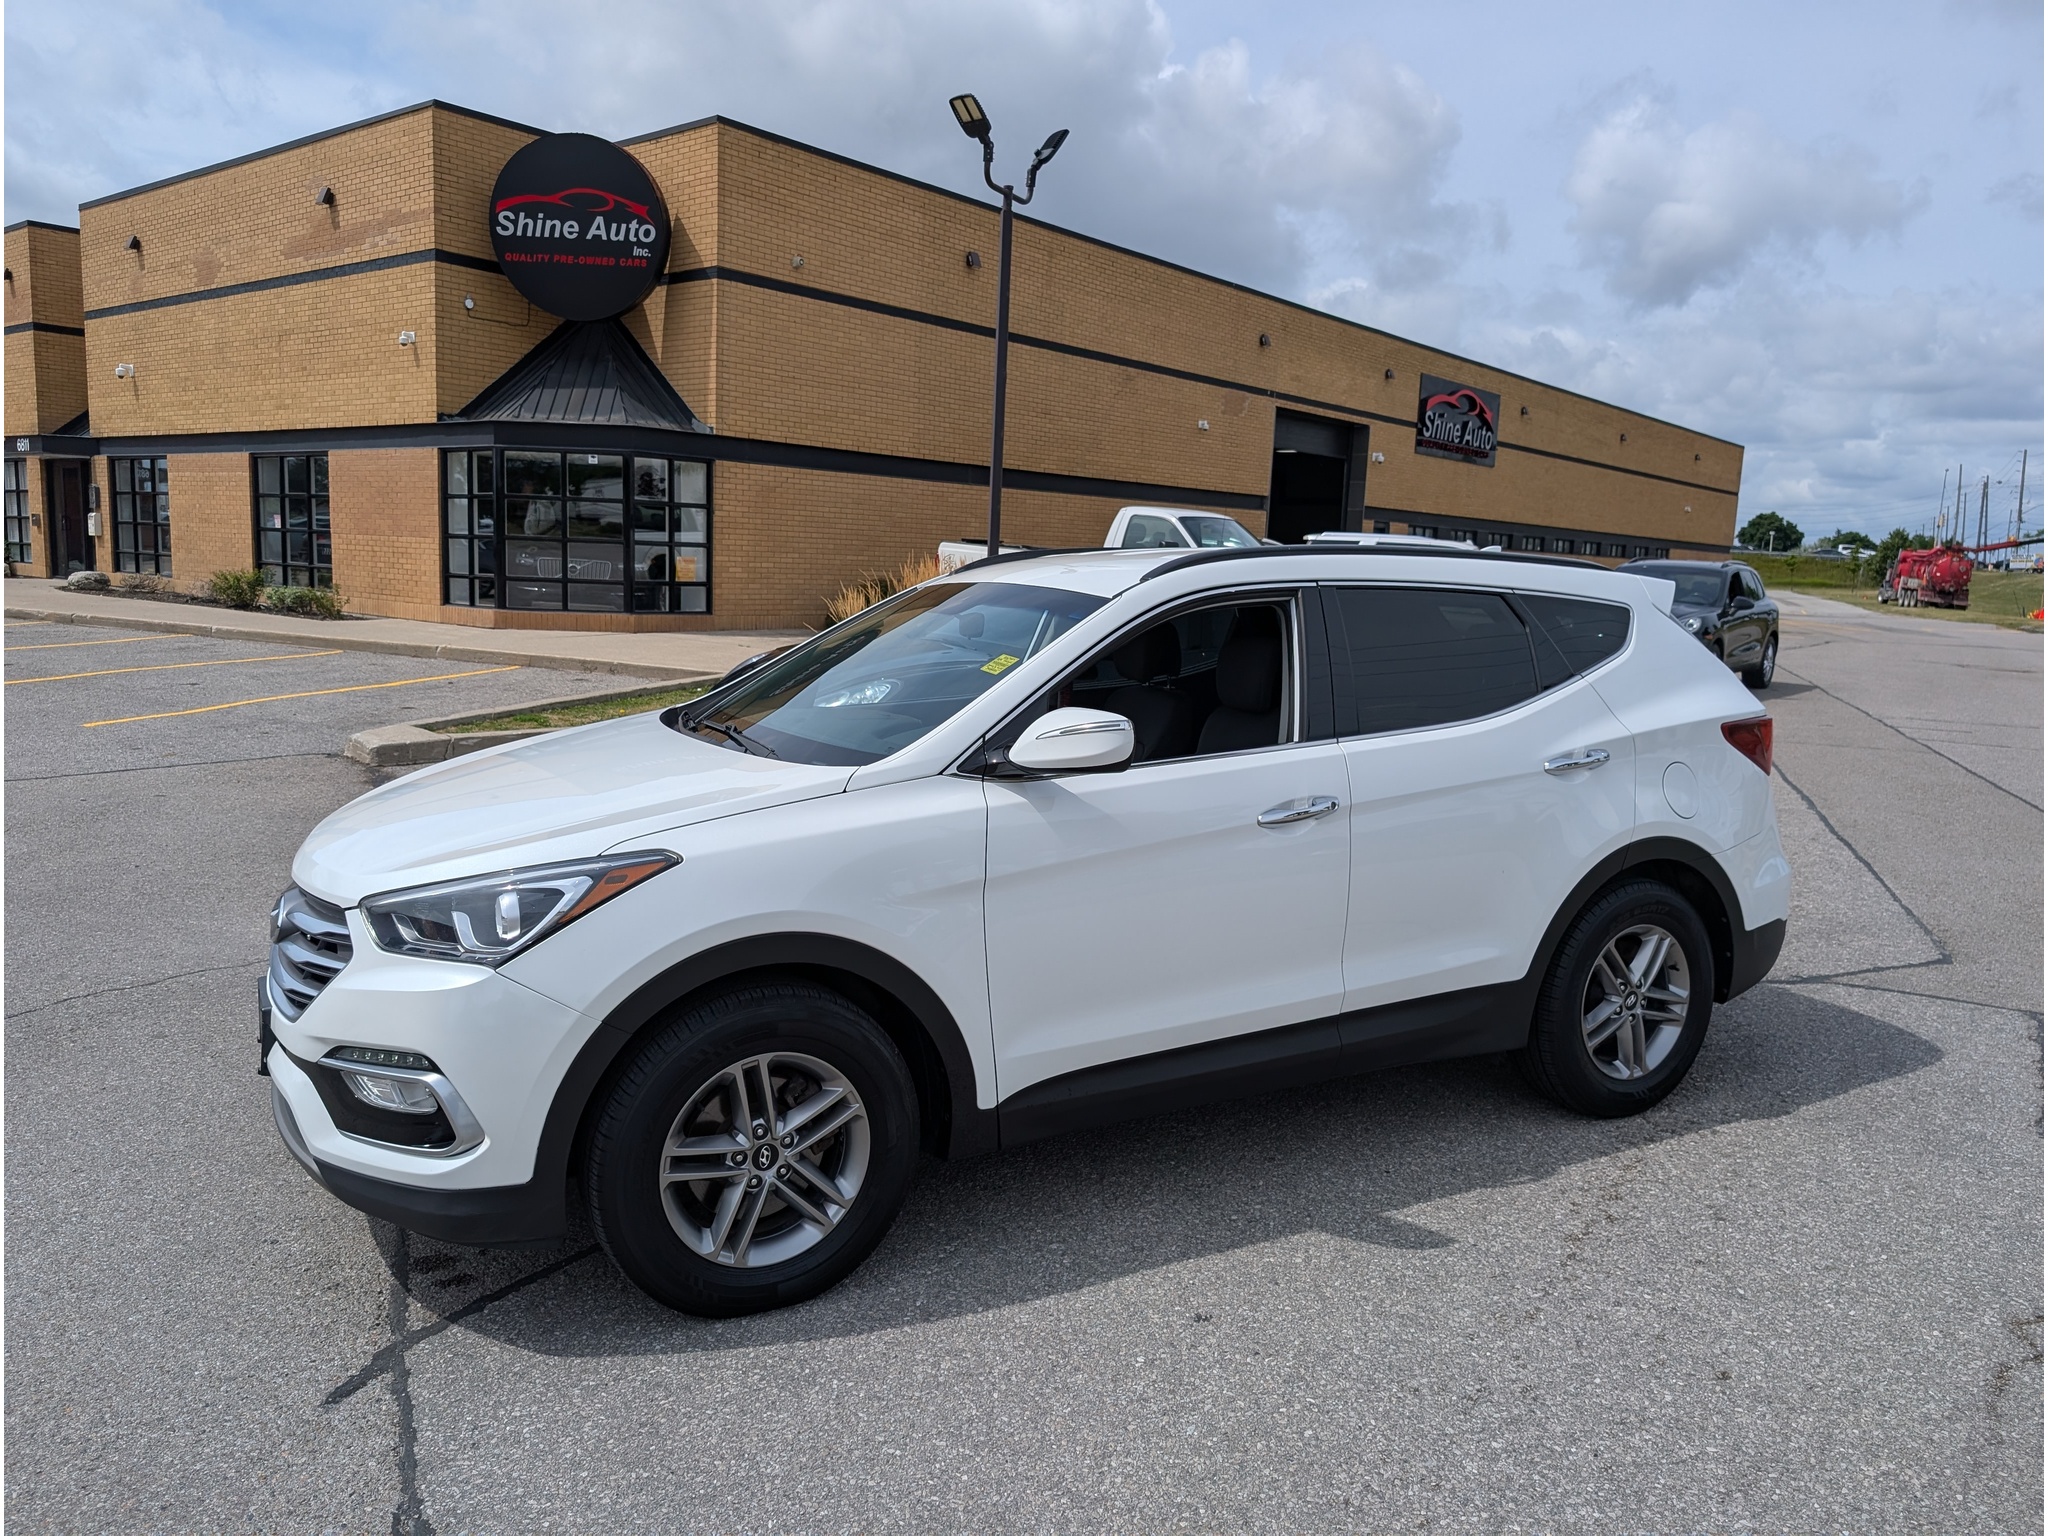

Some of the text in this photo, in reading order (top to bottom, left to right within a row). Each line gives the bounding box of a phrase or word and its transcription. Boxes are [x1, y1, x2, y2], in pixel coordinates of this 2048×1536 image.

[496, 210, 657, 243] Shine Auto
[632, 246, 652, 257] Inc.
[504, 252, 648, 267] QUALITY PRE-OWNED CARS
[1423, 411, 1461, 444] Shine
[1462, 420, 1493, 450] Auto
[16, 438, 30, 452] 6811
